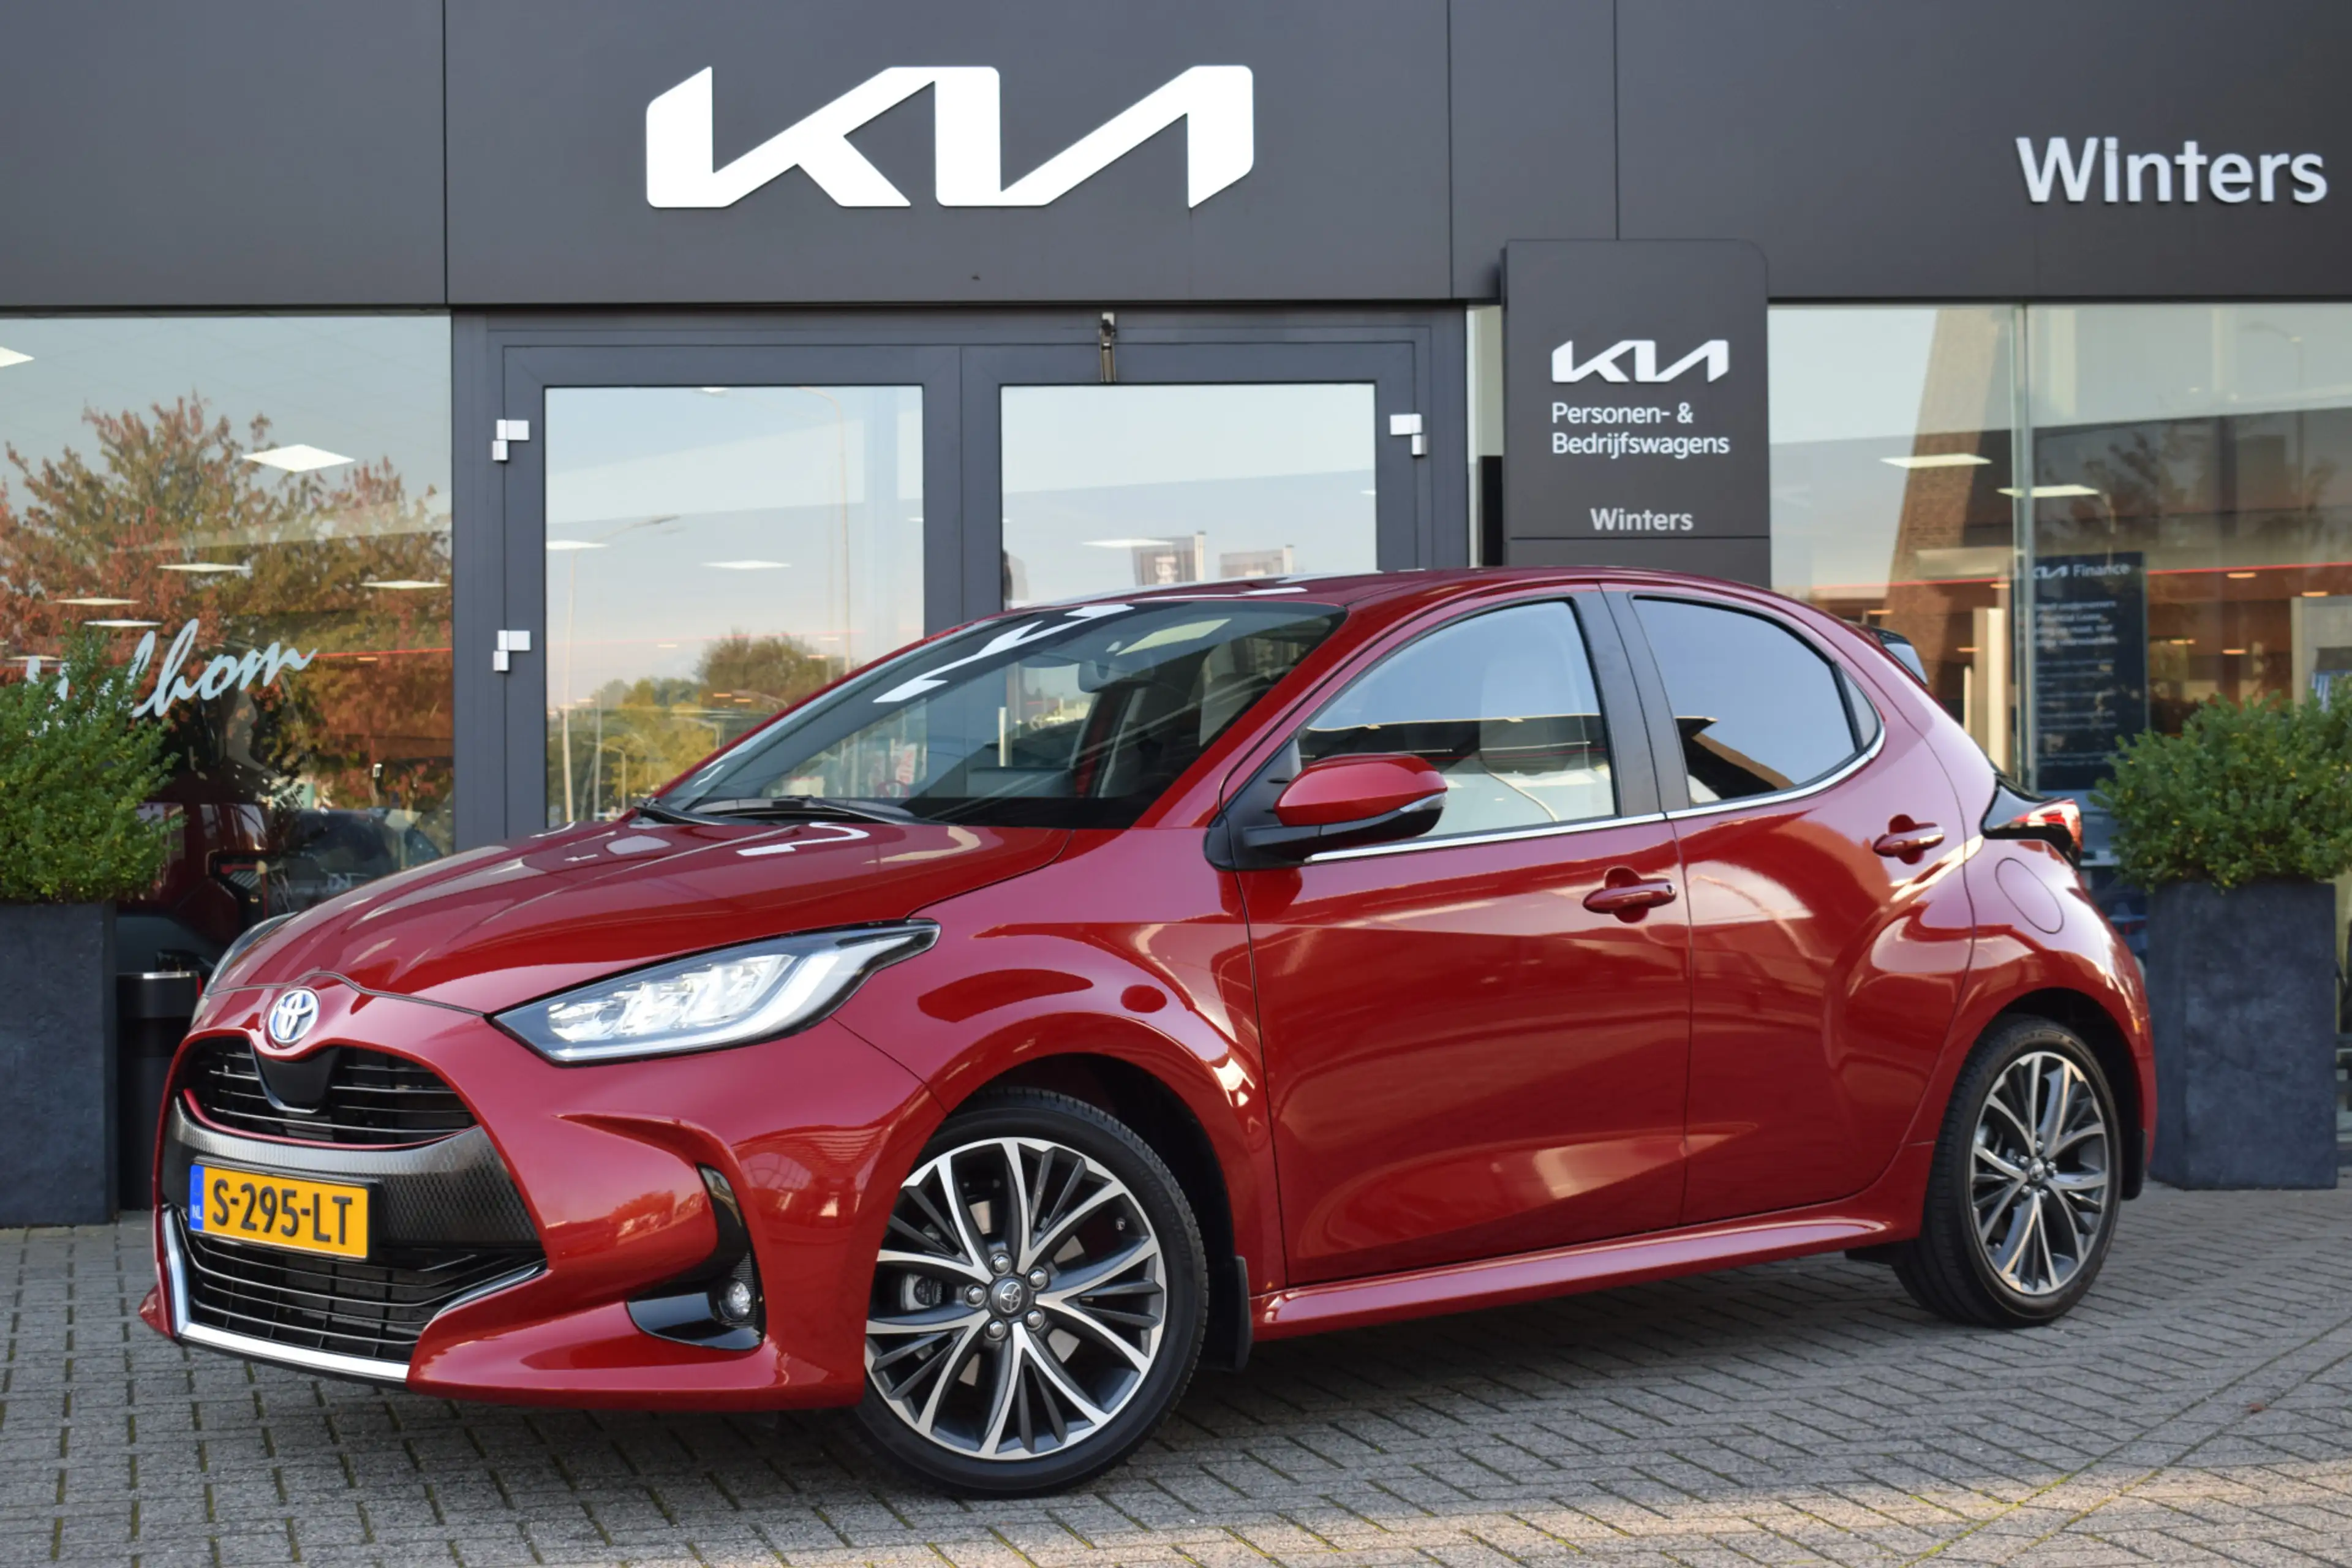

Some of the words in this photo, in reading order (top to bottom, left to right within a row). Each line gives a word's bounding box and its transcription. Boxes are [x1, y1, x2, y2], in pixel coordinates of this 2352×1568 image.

[646, 66, 1254, 208] KIA
[2016, 137, 2328, 203] Winters
[1552, 340, 1729, 382] KIA
[1552, 402, 1671, 424] Personen-
[1677, 402, 1694, 424] &
[1552, 432, 1730, 459] Bedrijfswagens
[1589, 508, 1694, 531] Winters
[2073, 563, 2132, 578] Finance
[26, 619, 318, 735] lkom
[192, 1205, 203, 1219] NL
[213, 1178, 353, 1246] S-295-LT
